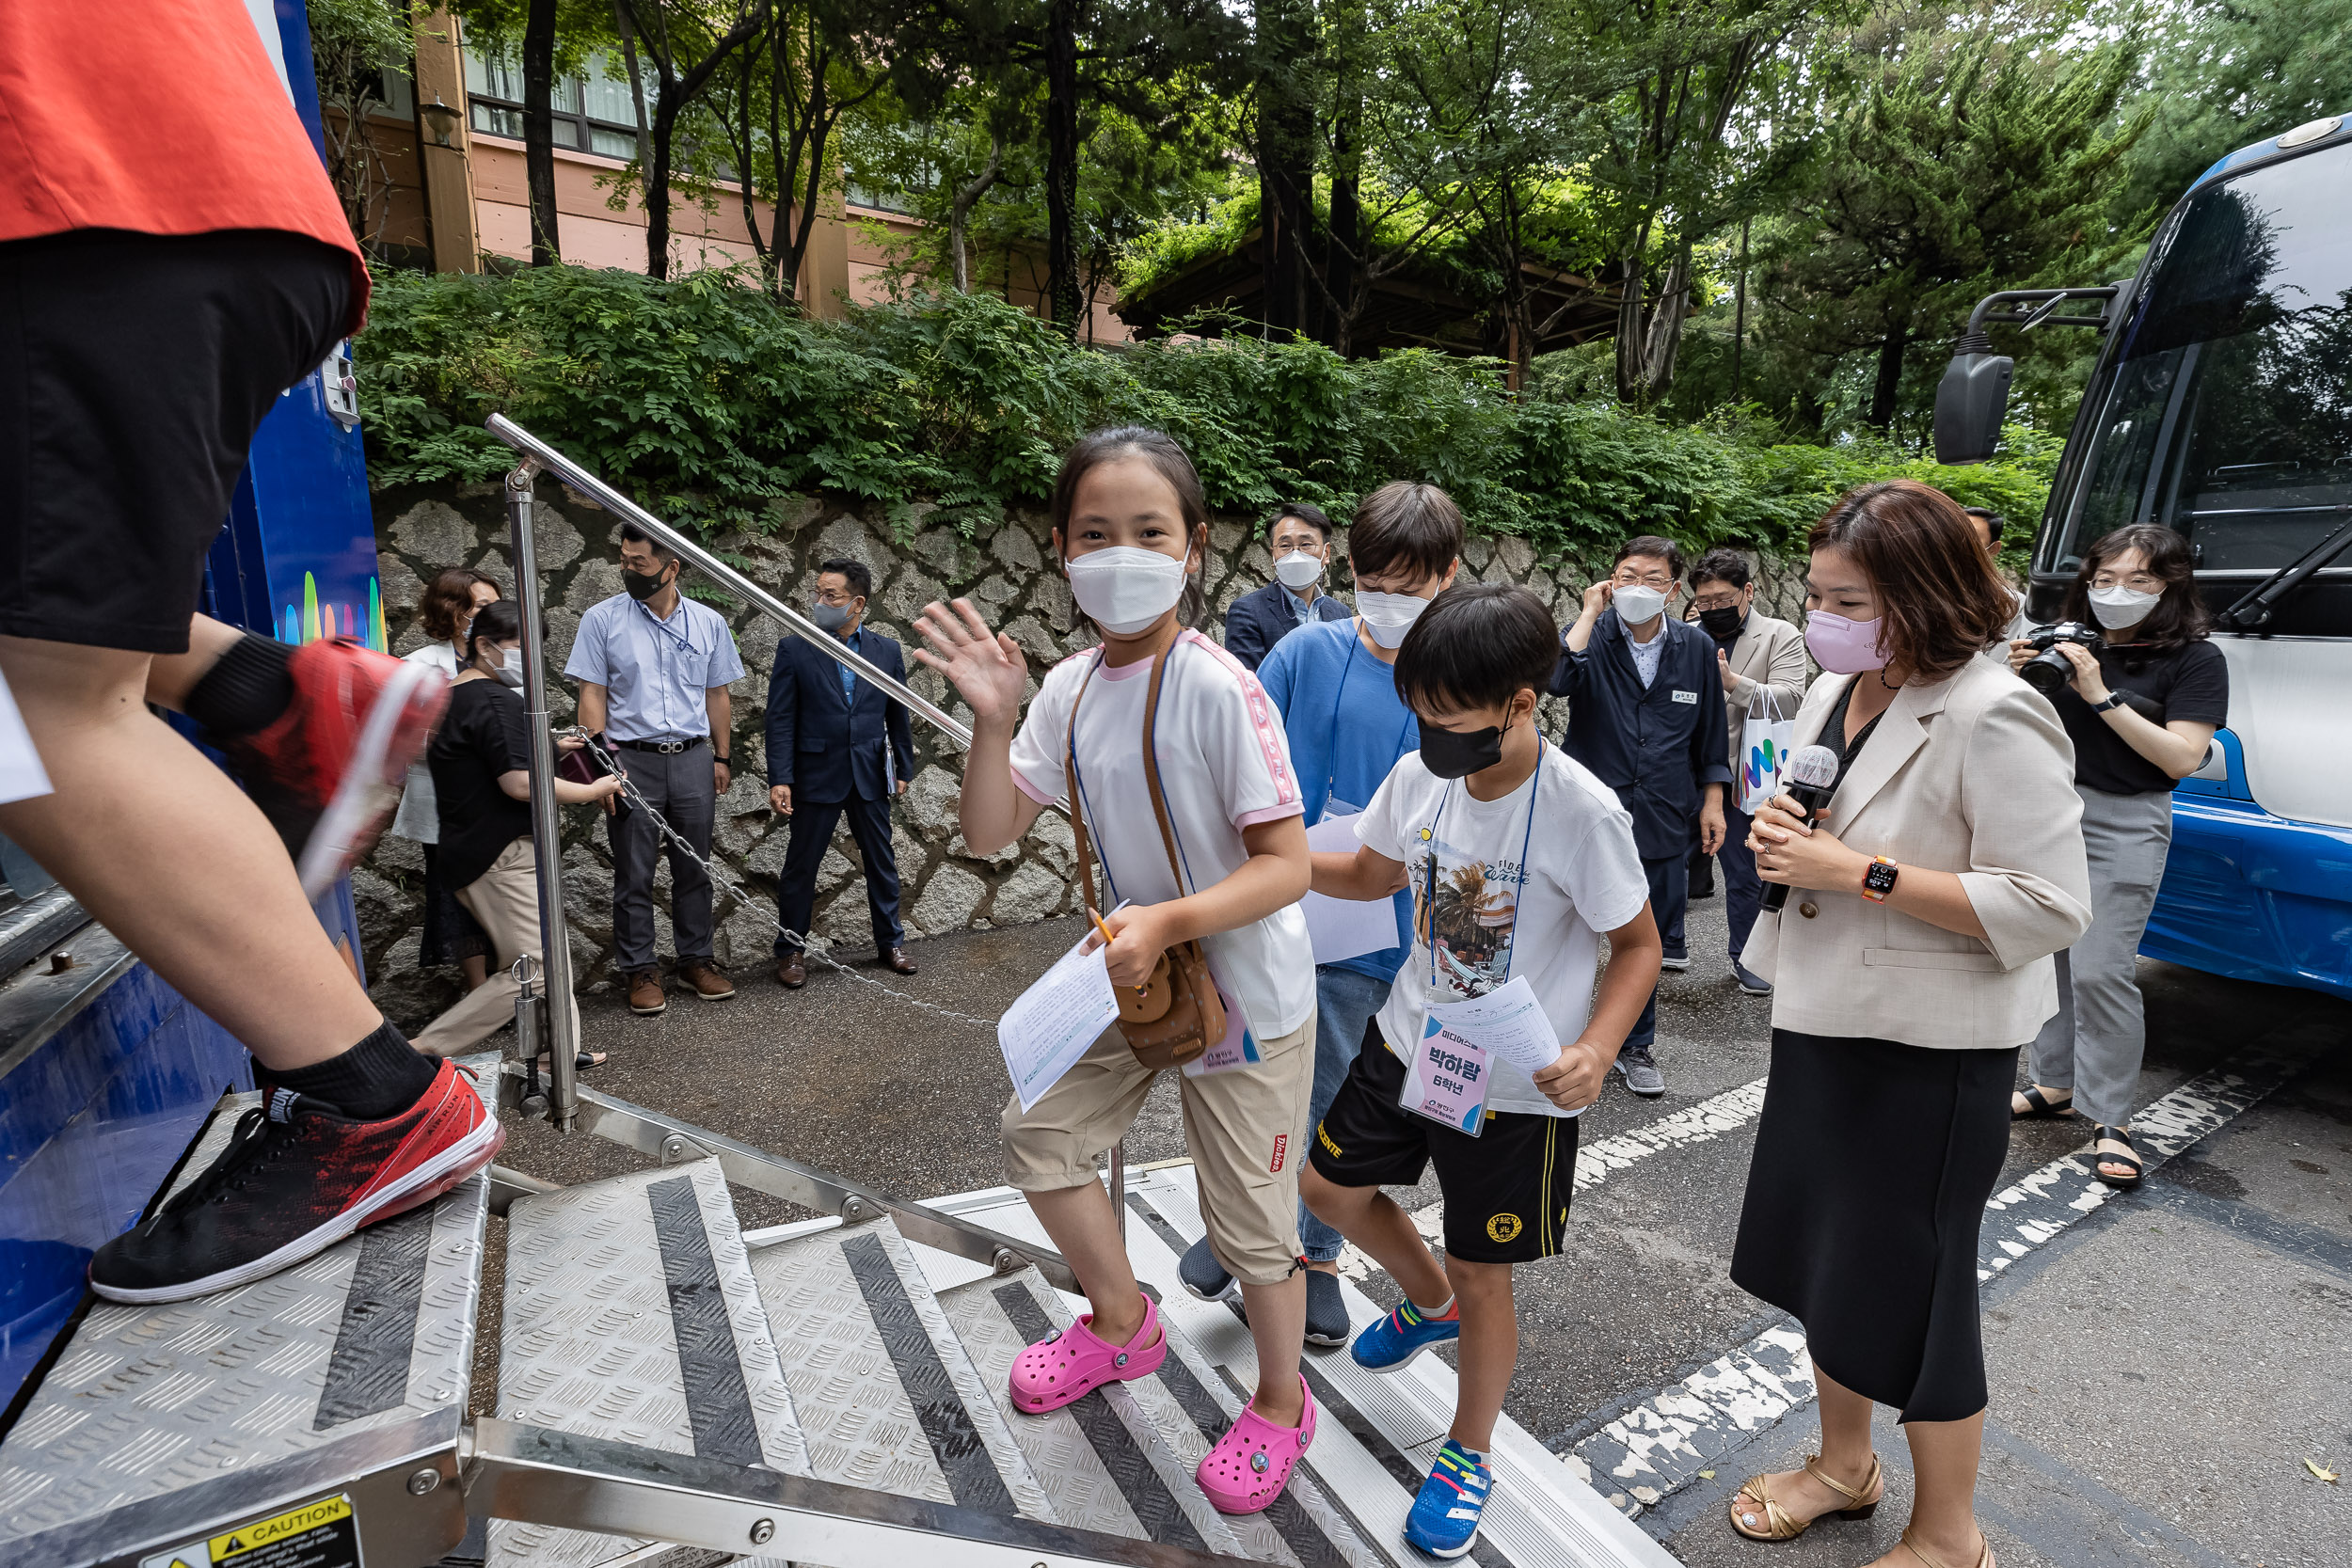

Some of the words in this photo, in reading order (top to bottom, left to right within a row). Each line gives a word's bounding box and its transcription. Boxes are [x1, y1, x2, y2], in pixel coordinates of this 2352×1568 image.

[1252, 697, 1266, 723] FILA
[1261, 729, 1277, 753] FILA
[1274, 759, 1284, 785] FILA
[1429, 1046, 1481, 1082] 박하람
[1433, 1074, 1464, 1096] 6학년
[253, 1502, 340, 1541] CAUTION
